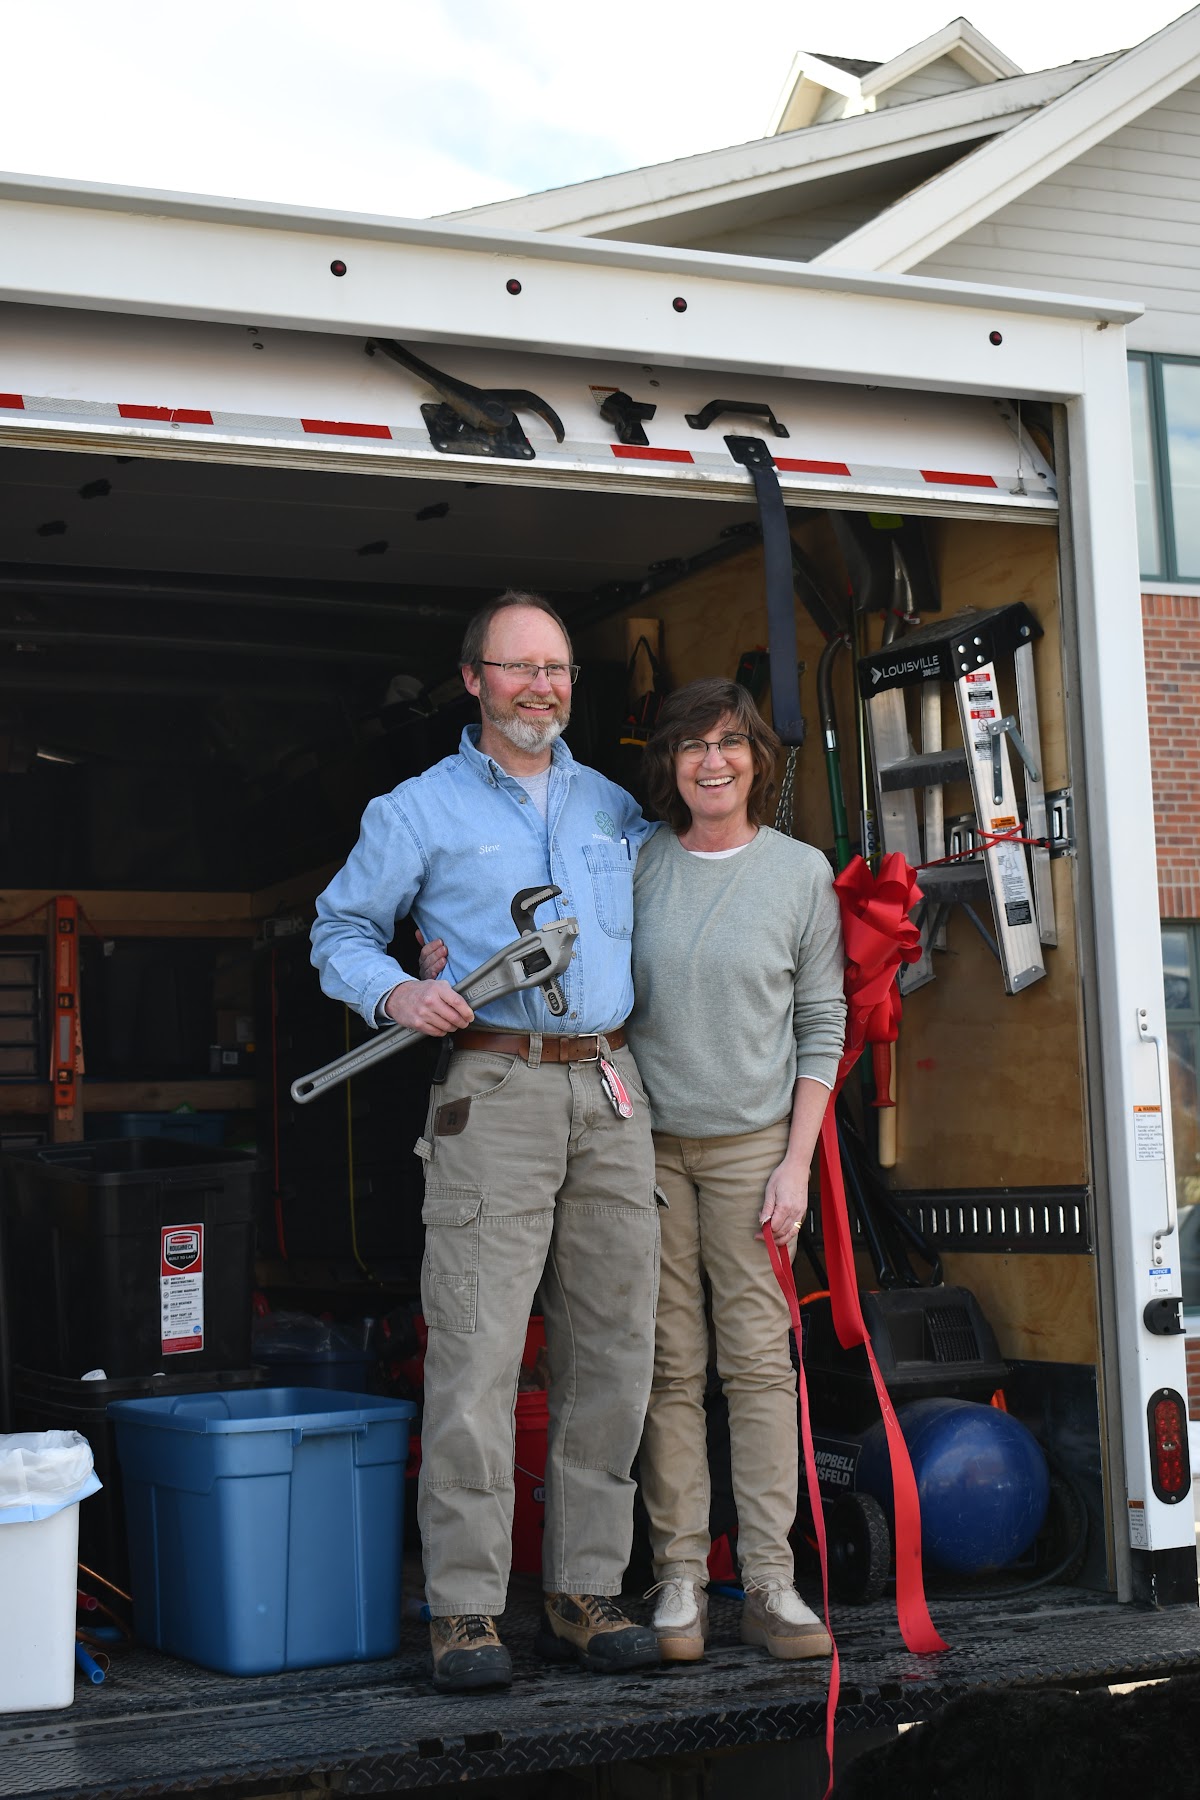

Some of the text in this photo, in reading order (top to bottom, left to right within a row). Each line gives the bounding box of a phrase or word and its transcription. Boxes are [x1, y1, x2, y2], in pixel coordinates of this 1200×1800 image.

[882, 655, 939, 678] LOUISVILLE
[169, 1244, 194, 1252] ROUGHNECK
[815, 1451, 854, 1471] MPBELL
